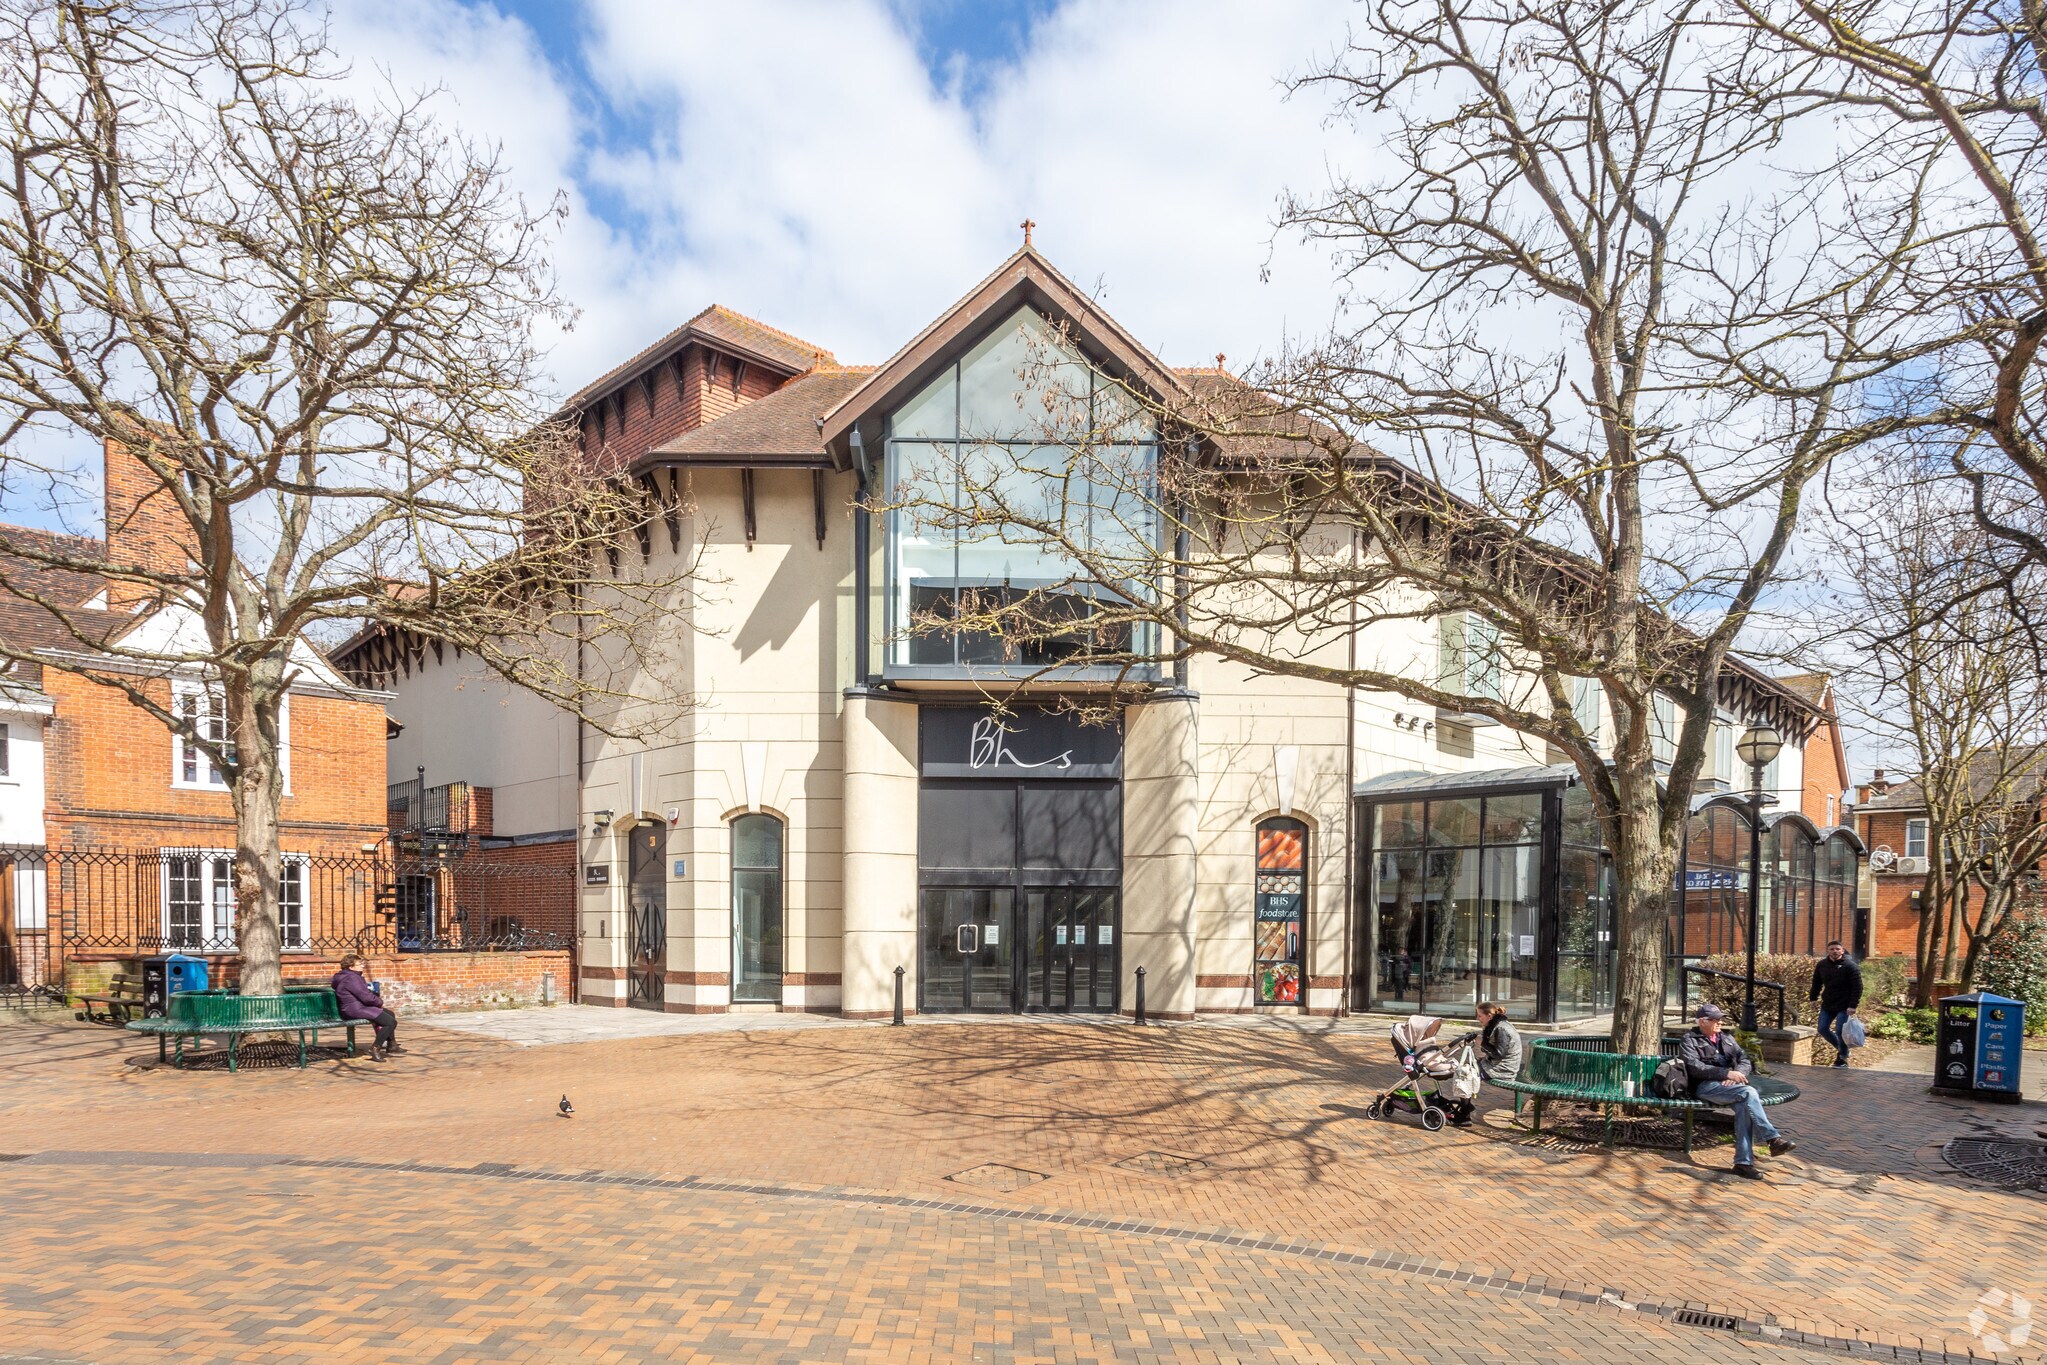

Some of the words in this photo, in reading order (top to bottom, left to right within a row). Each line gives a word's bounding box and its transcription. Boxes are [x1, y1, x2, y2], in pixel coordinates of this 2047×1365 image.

[1270, 896, 1289, 906] BHS
[1985, 1022, 2008, 1030] Paper
[1985, 1042, 2005, 1050] Cans
[1981, 1063, 2007, 1071] Plastic
